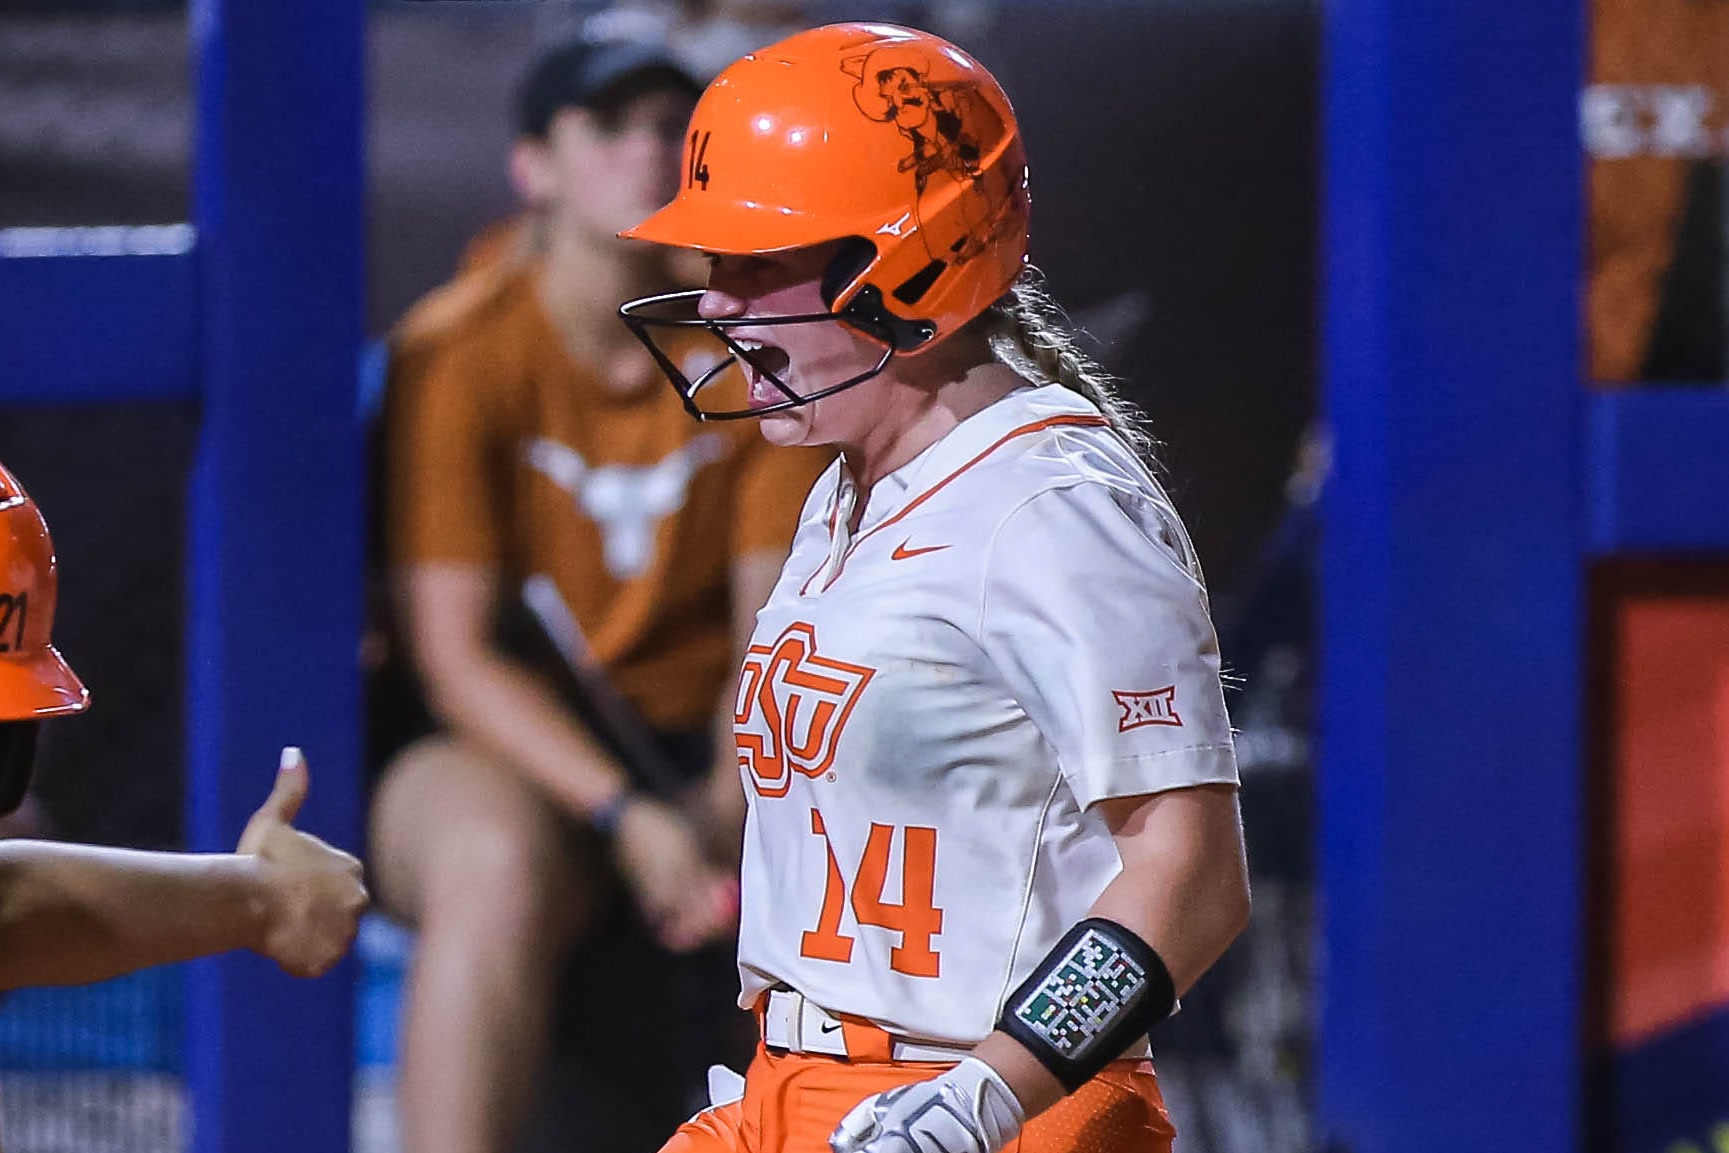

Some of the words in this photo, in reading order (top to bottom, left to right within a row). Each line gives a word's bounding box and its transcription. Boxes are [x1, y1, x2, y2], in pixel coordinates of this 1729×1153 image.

[688, 129, 711, 192] 14
[1111, 685, 1184, 733] XII
[799, 807, 943, 978] 14
